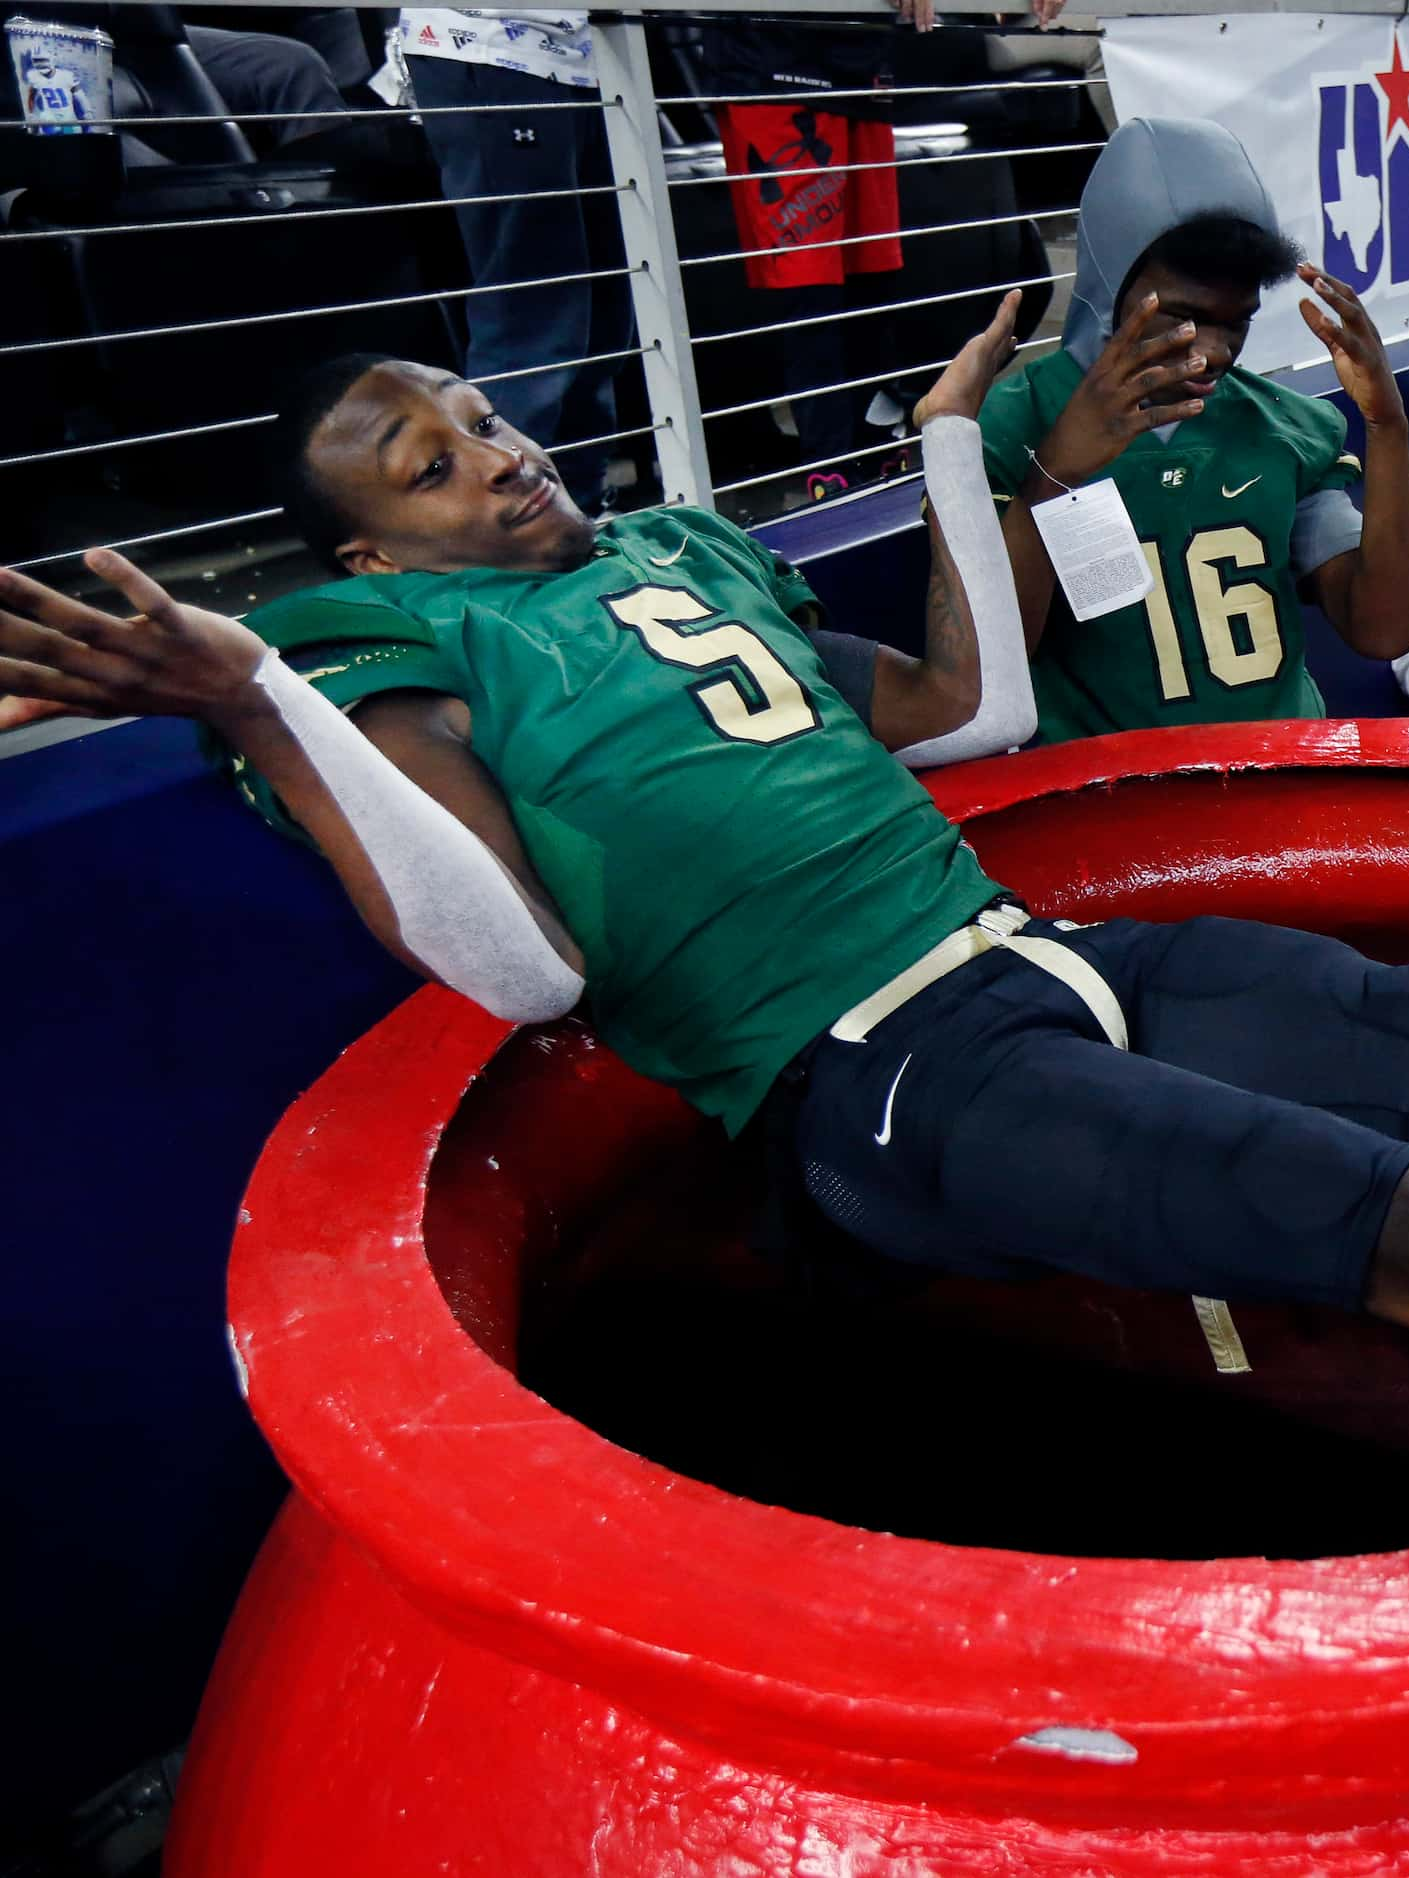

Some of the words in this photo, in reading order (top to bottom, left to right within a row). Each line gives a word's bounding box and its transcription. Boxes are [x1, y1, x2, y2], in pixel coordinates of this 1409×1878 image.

[42, 87, 69, 110] 21
[598, 584, 822, 747] 5
[1140, 524, 1285, 703] 16
